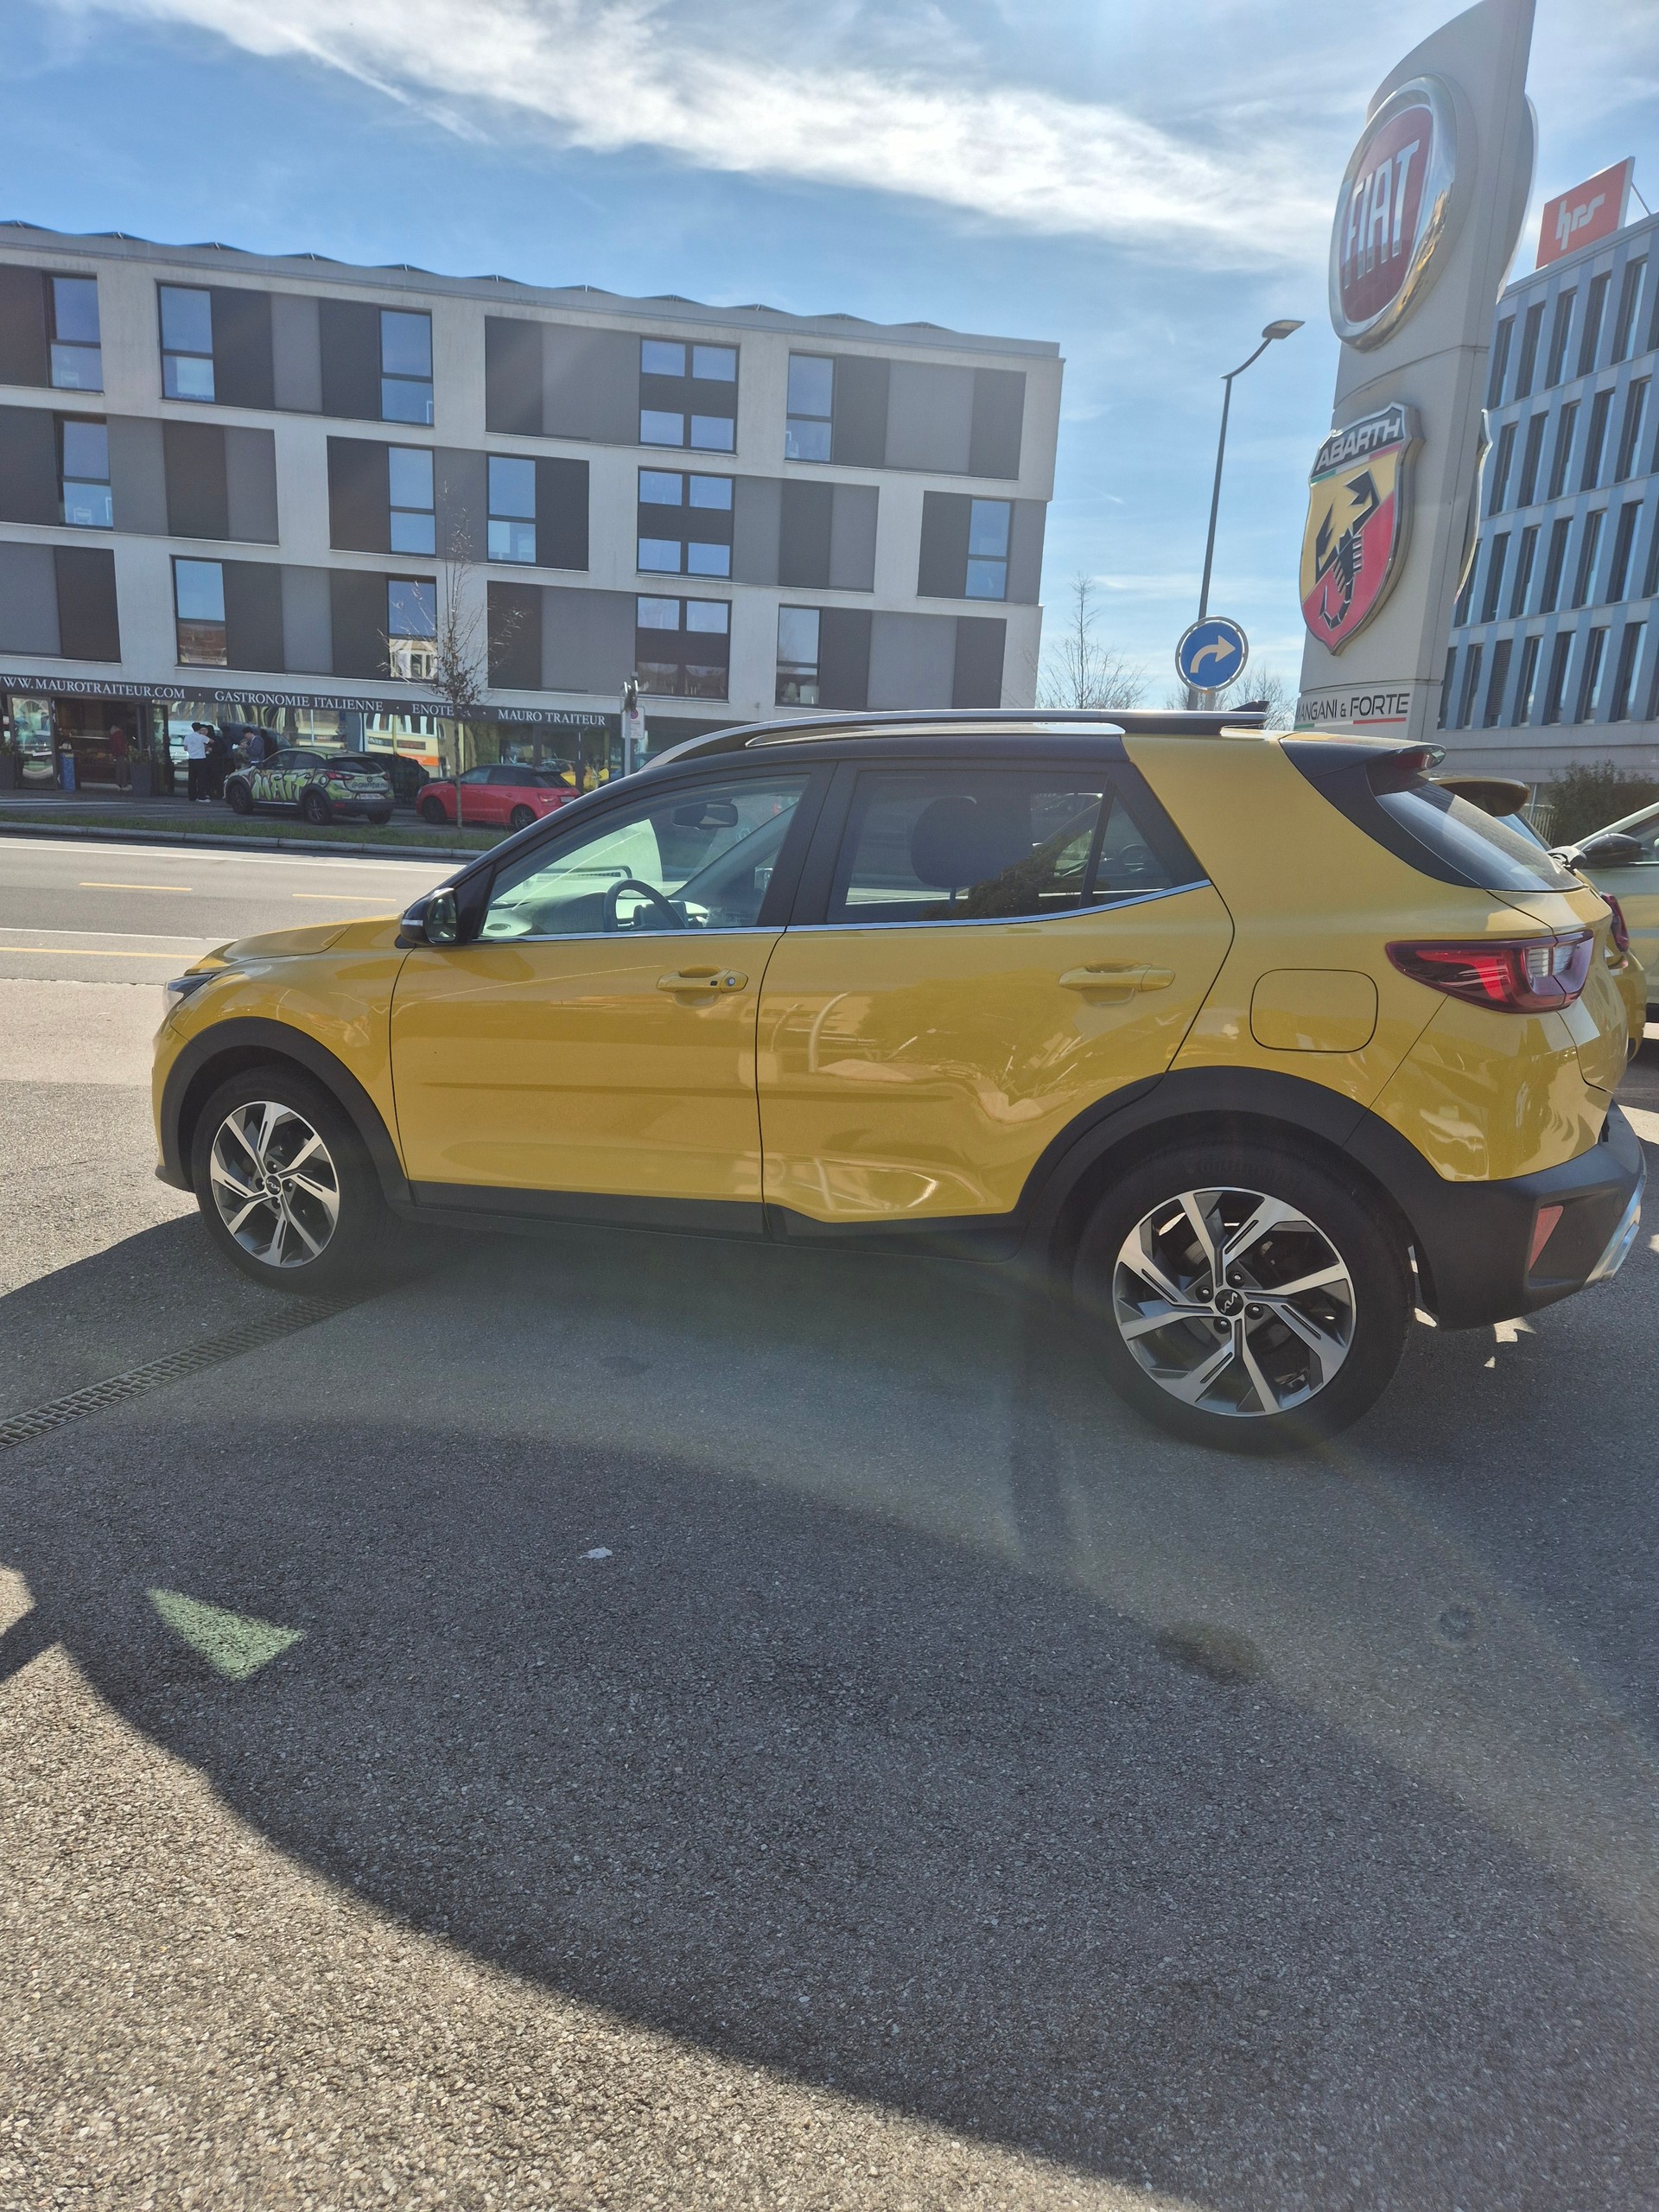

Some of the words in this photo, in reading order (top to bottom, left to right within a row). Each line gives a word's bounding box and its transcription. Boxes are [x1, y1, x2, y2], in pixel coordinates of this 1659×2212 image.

[1344, 138, 1421, 290] FIAT
[1555, 193, 1605, 251] hrs
[1315, 418, 1401, 472] ABARTH
[0, 676, 186, 699] WW.MAUROTRAITEUR.COM
[214, 690, 310, 708] GASTRONOMIE
[314, 697, 384, 712] ITALIENNE
[411, 703, 472, 718] ENOTE
[1340, 702, 1347, 718] &
[1350, 692, 1411, 717] FORTE
[498, 709, 543, 722] MAURO
[545, 712, 605, 726] TRAITEUR
